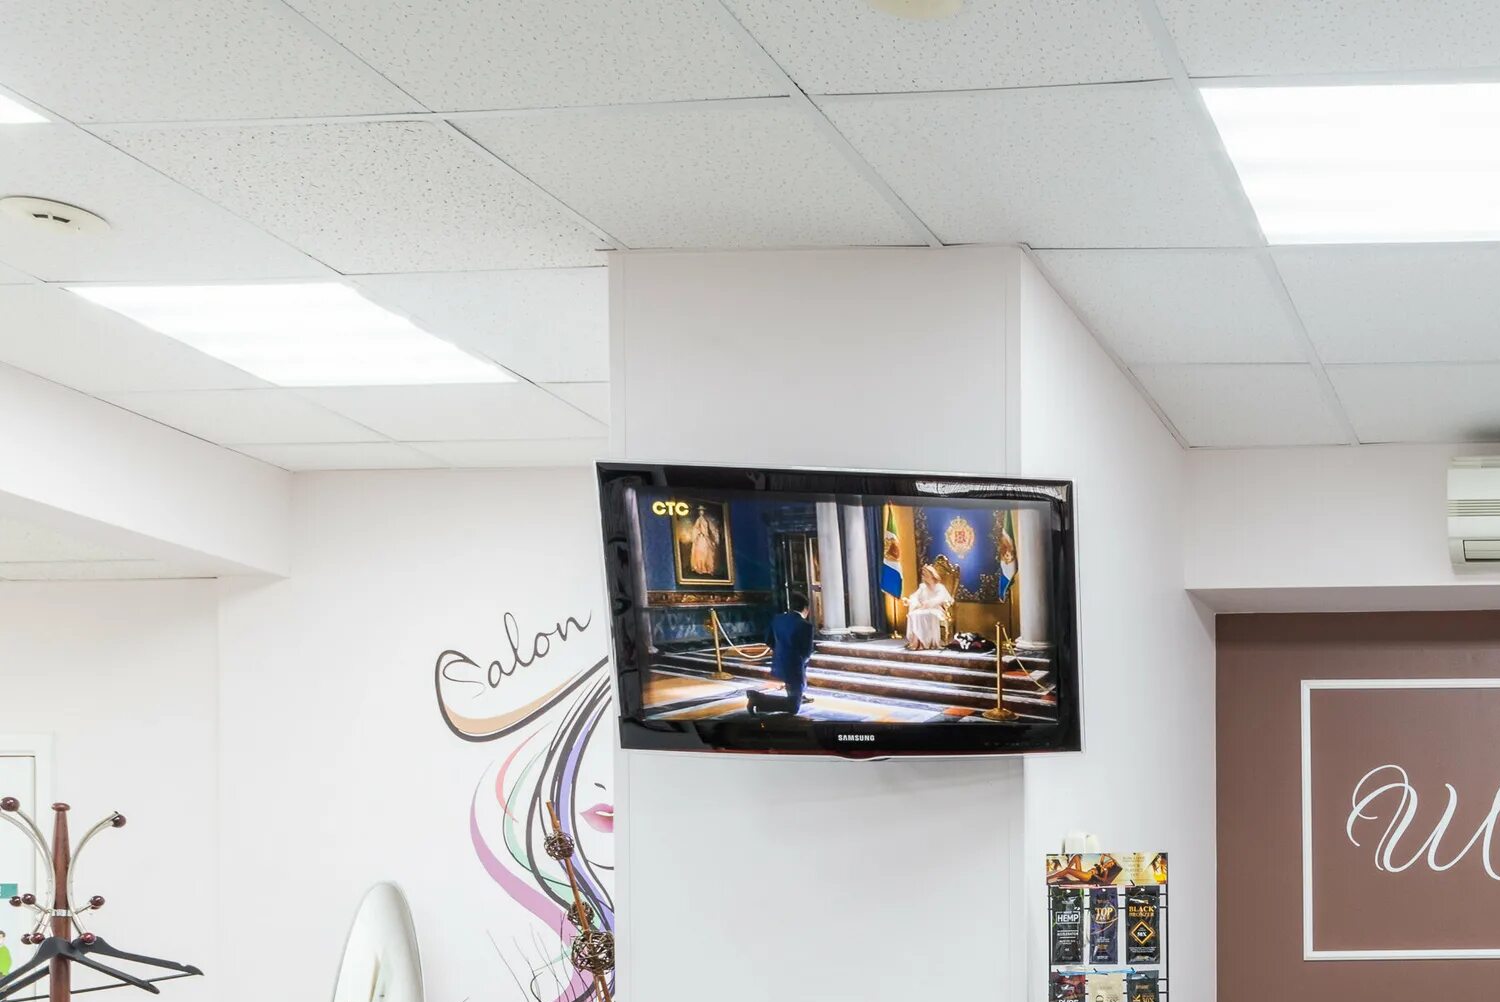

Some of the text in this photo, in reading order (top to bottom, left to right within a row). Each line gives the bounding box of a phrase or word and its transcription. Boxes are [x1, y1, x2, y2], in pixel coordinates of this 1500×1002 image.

[434, 610, 592, 700] Salon
[837, 734, 876, 742] SAMSUNG
[1128, 905, 1155, 913] BLACK
[1056, 914, 1080, 923] HEMP
